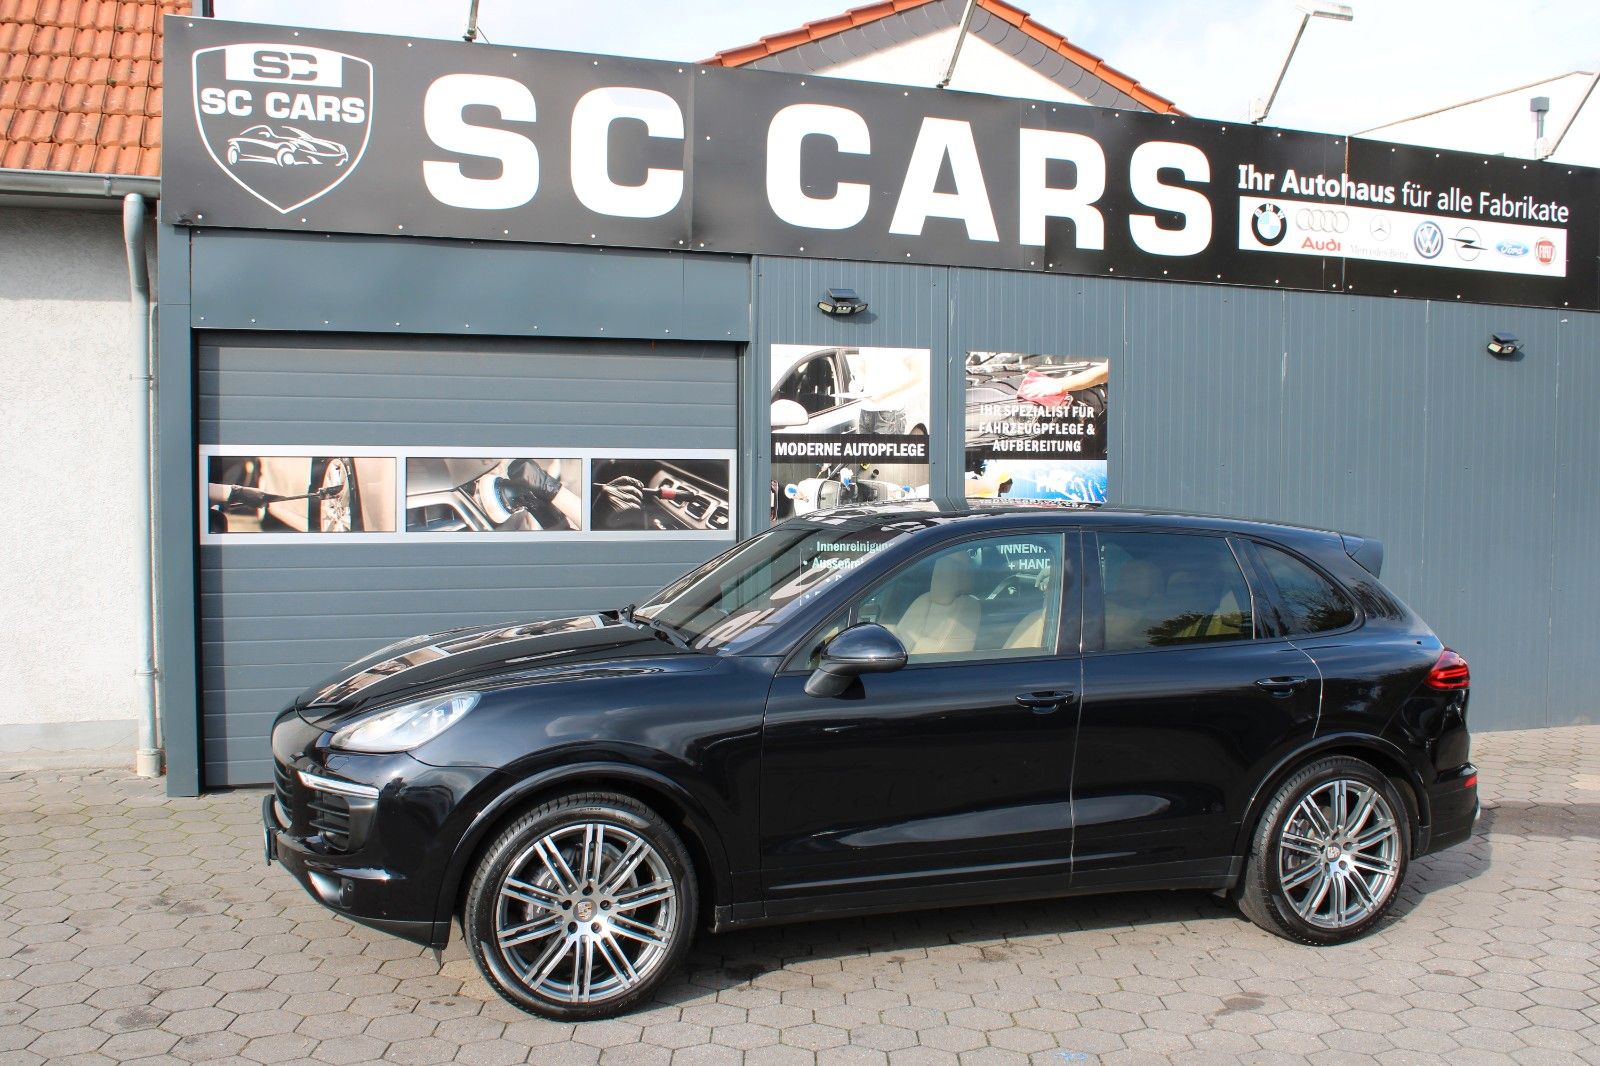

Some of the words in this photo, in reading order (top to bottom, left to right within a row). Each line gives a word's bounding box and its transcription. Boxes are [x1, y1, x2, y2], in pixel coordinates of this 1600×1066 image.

[200, 88, 253, 116] SC
[265, 91, 366, 124] CARS
[422, 73, 685, 219] SC
[766, 103, 1213, 256] CARS
[1238, 164, 1274, 192] Ihr
[1281, 169, 1395, 204] Autohaus
[1401, 181, 1432, 208] für
[1437, 188, 1473, 214] alle
[1479, 192, 1569, 223] Fabrikate
[1301, 237, 1342, 252] Audi
[980, 405, 1001, 417] IHR
[1003, 405, 1070, 418] SPEZIALIST
[1072, 404, 1094, 418] FÜR
[979, 422, 1084, 435] FAHRZEUGPFLEGE
[1086, 424, 1095, 435] &
[775, 441, 842, 457] MODERNE
[844, 442, 925, 458] AUTOPFLEGE
[992, 440, 1081, 453] AUFBEREITUNG
